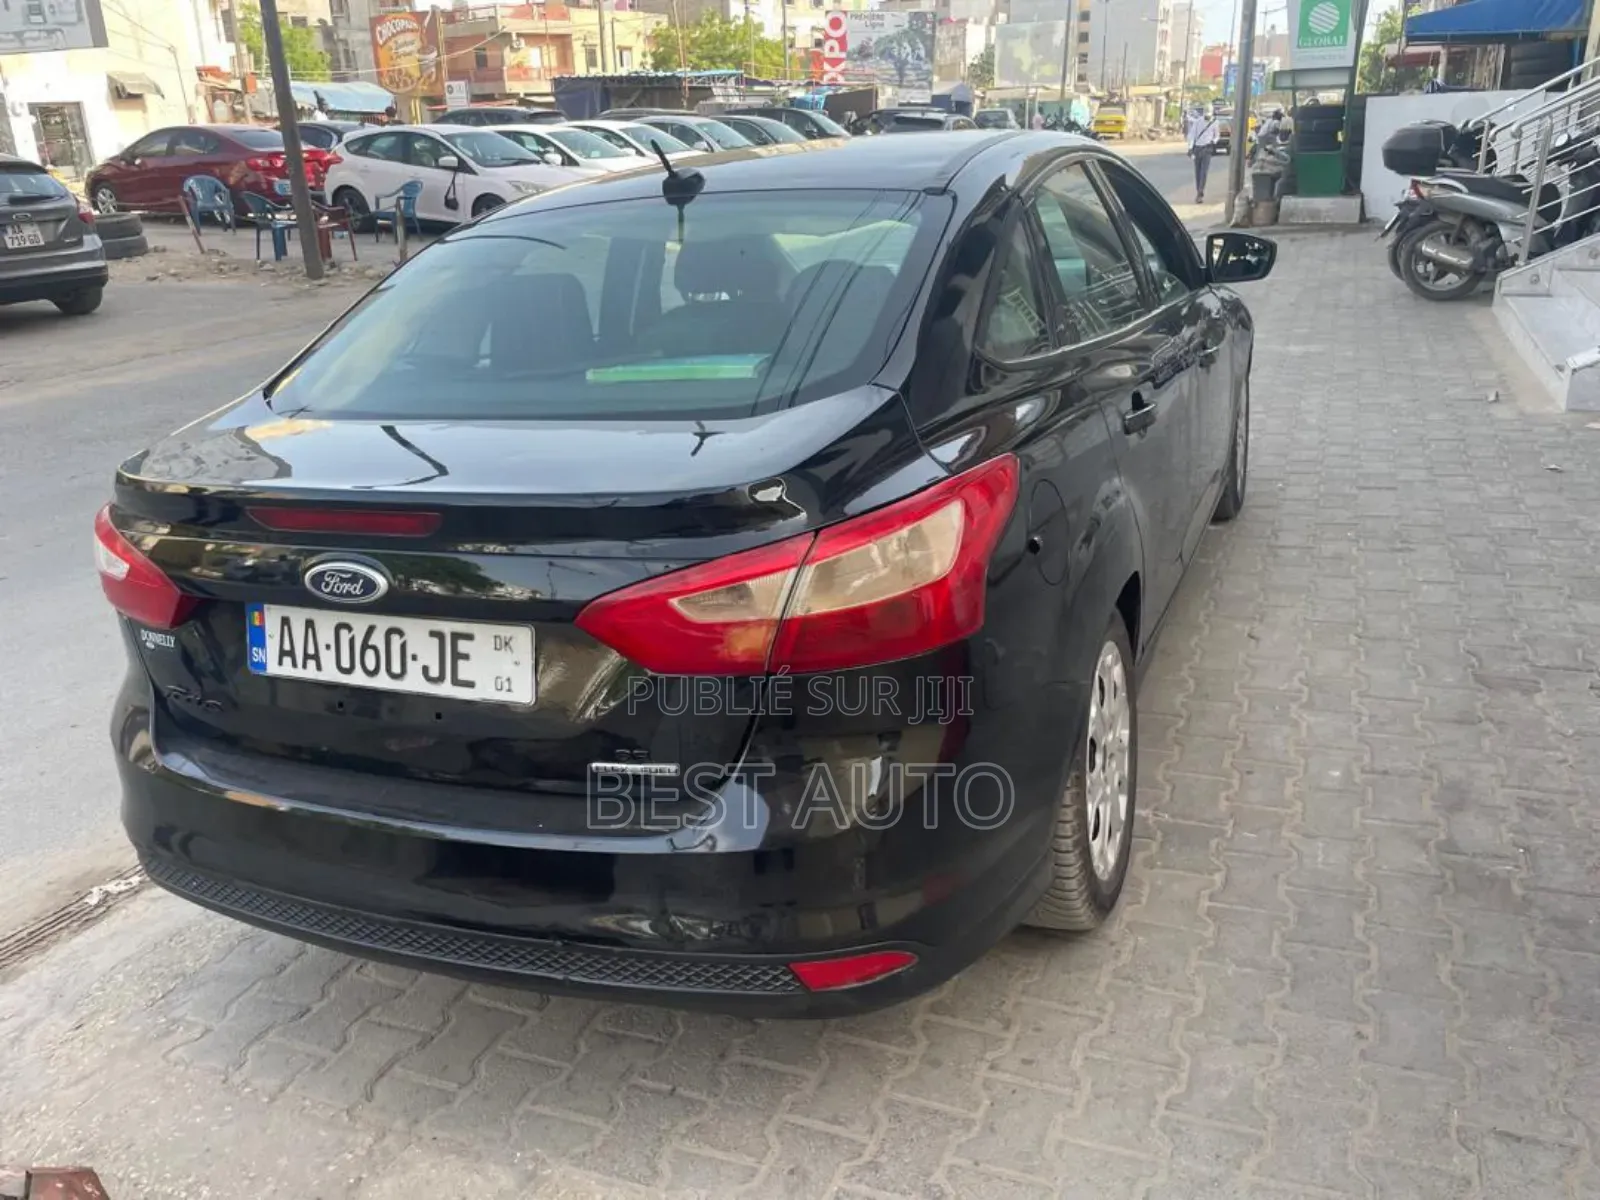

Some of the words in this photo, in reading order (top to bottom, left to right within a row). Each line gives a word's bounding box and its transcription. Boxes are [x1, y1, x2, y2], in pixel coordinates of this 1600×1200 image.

[1299, 35, 1345, 47] GLOBAL
[320, 571, 364, 596] Ford
[493, 635, 514, 652] DK
[252, 647, 266, 663] SN
[494, 676, 514, 693] 01
